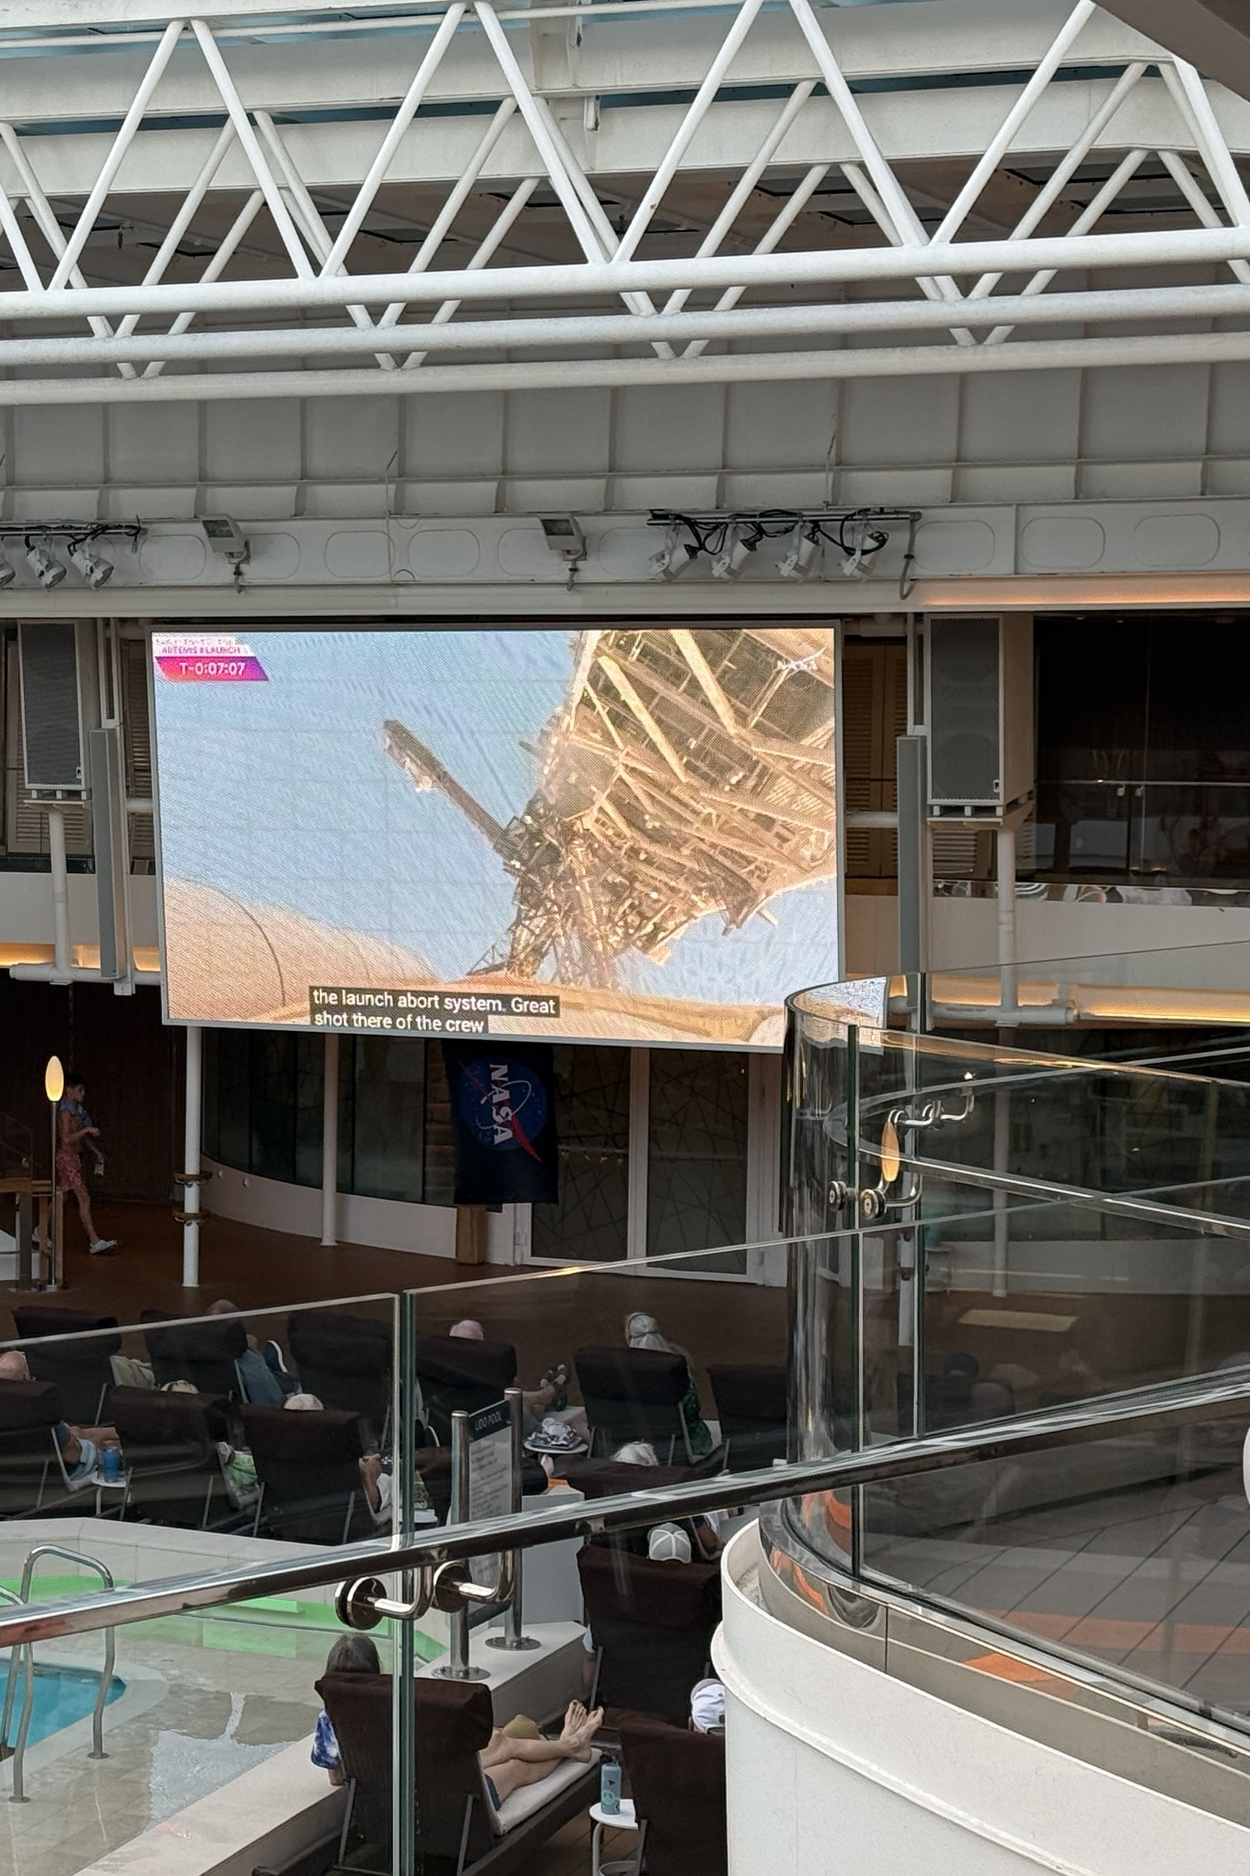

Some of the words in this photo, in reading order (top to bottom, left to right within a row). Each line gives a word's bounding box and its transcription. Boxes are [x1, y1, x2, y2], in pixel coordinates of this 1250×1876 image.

[161, 646, 198, 654] ARTEMIS
[205, 646, 241, 654] LAUNCH
[178, 662, 246, 676] T-0:07:07
[312, 988, 338, 1005] the
[341, 989, 394, 1007] launch
[397, 992, 440, 1009] abort
[444, 996, 507, 1014] system.
[511, 997, 556, 1014] Great
[314, 1010, 349, 1027] shot
[352, 1012, 393, 1029] there
[395, 1014, 413, 1030] of
[415, 1014, 442, 1031] the
[445, 1019, 485, 1033] crew
[489, 1063, 514, 1145] NASA
